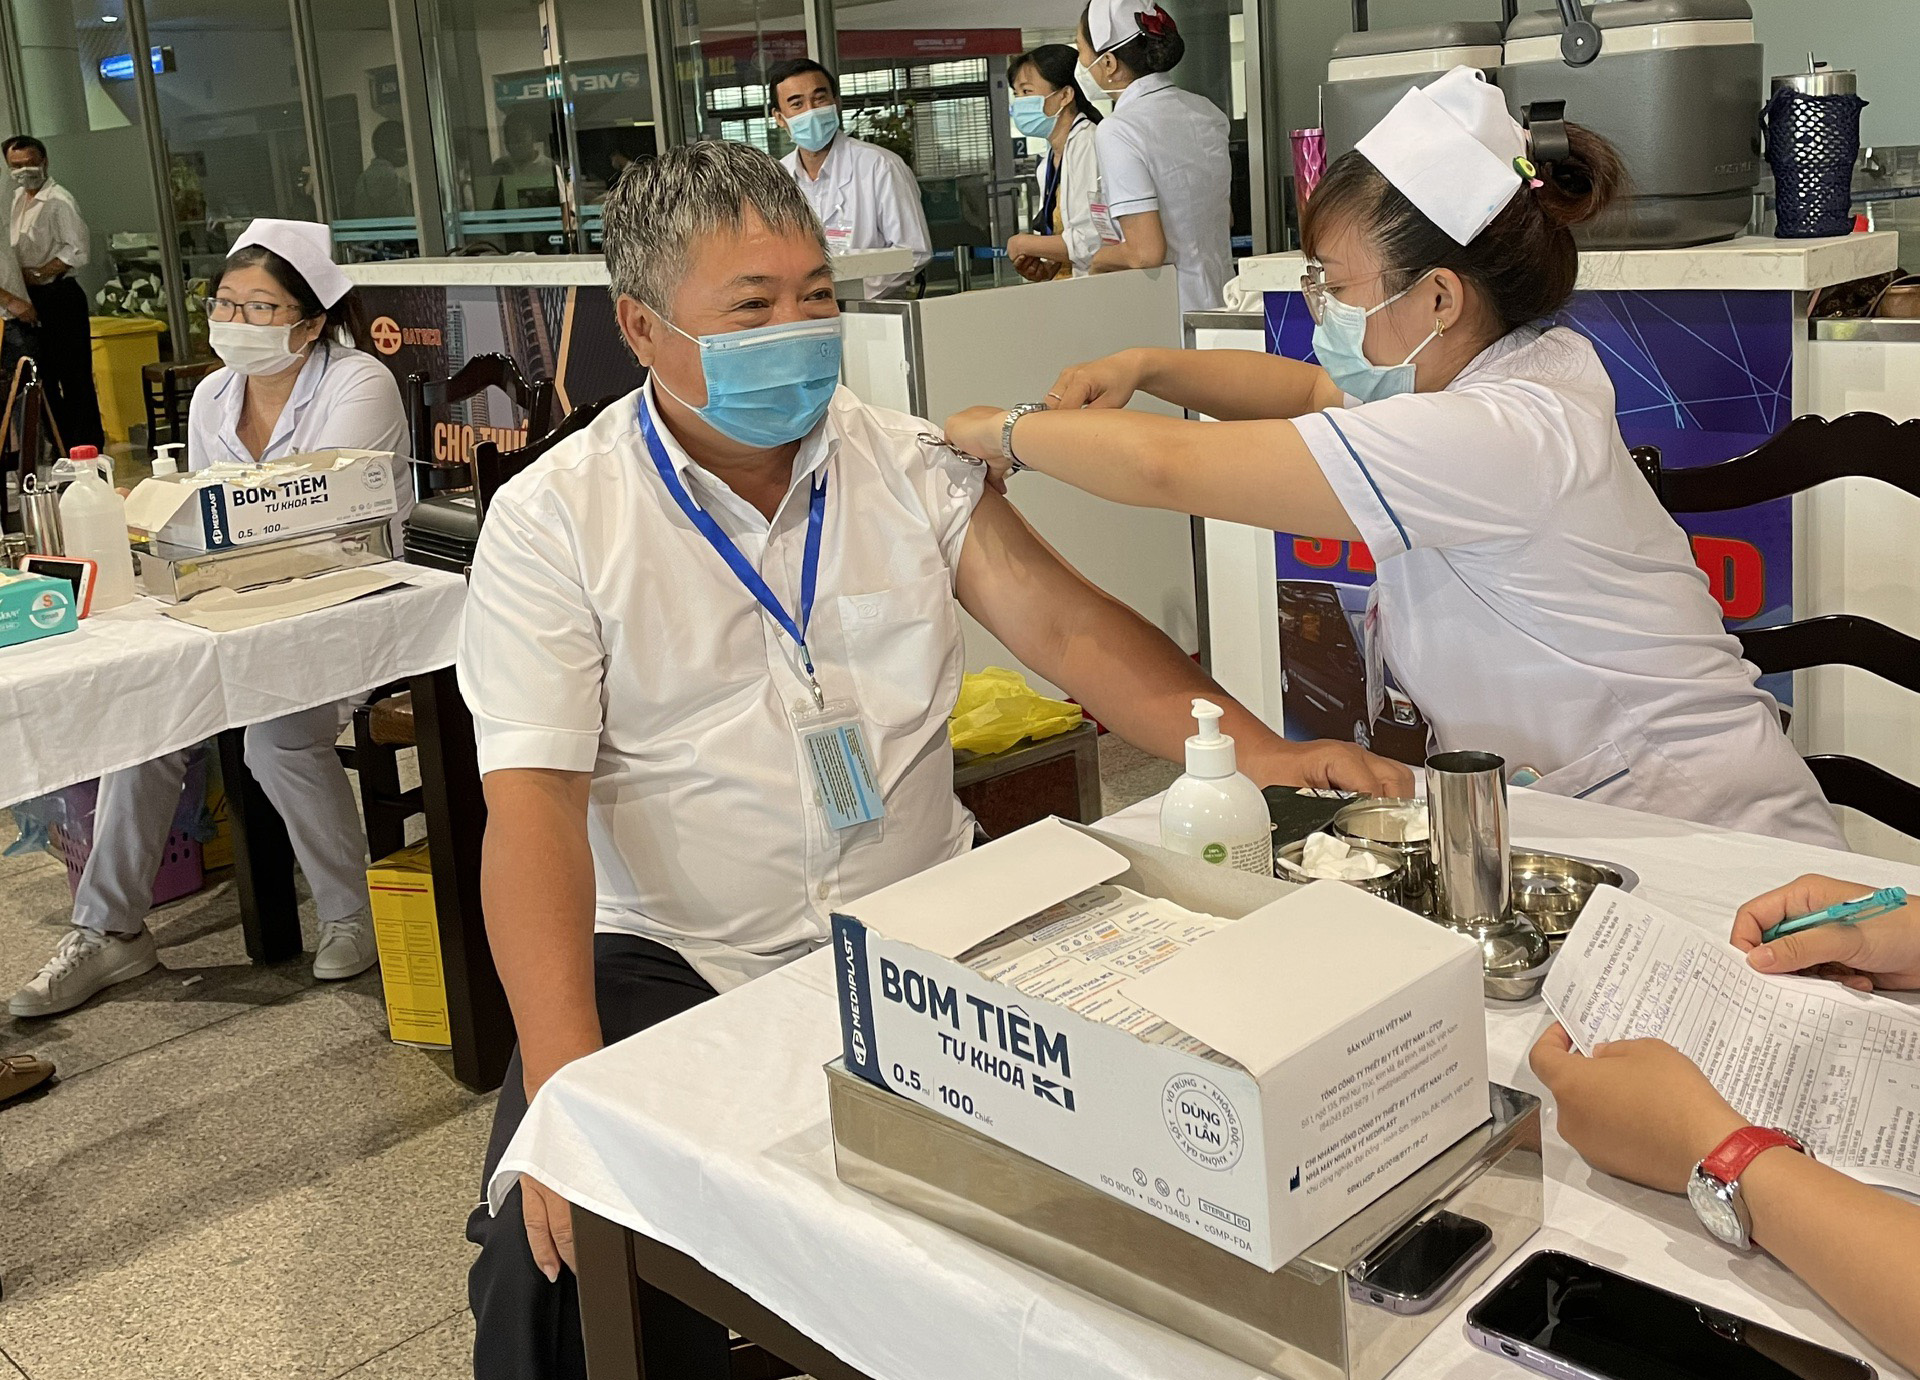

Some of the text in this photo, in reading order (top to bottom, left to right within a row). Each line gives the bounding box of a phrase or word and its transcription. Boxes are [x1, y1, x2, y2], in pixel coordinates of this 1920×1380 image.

[1016, 141, 1024, 156] 2
[434, 422, 475, 464] CHO
[238, 529, 253, 539] 0.5
[263, 523, 281, 534] 100
[42, 594, 53, 608] S
[843, 936, 862, 1029] MEDIPLAST
[880, 957, 960, 1031] BƠM
[966, 993, 1072, 1079] TIÊM
[893, 1063, 921, 1091] 0.5
[937, 1031, 966, 1065] TỰ
[1032, 1073, 1076, 1113] KI
[938, 1084, 974, 1116] 100
[1181, 1101, 1220, 1127] DÙNG
[1184, 1121, 1221, 1147] 1 LẦN
[1100, 1174, 1252, 1252] ISO 9001 ISO 13485 cGMP-FDA
[1202, 1203, 1247, 1228] STERILE EO
